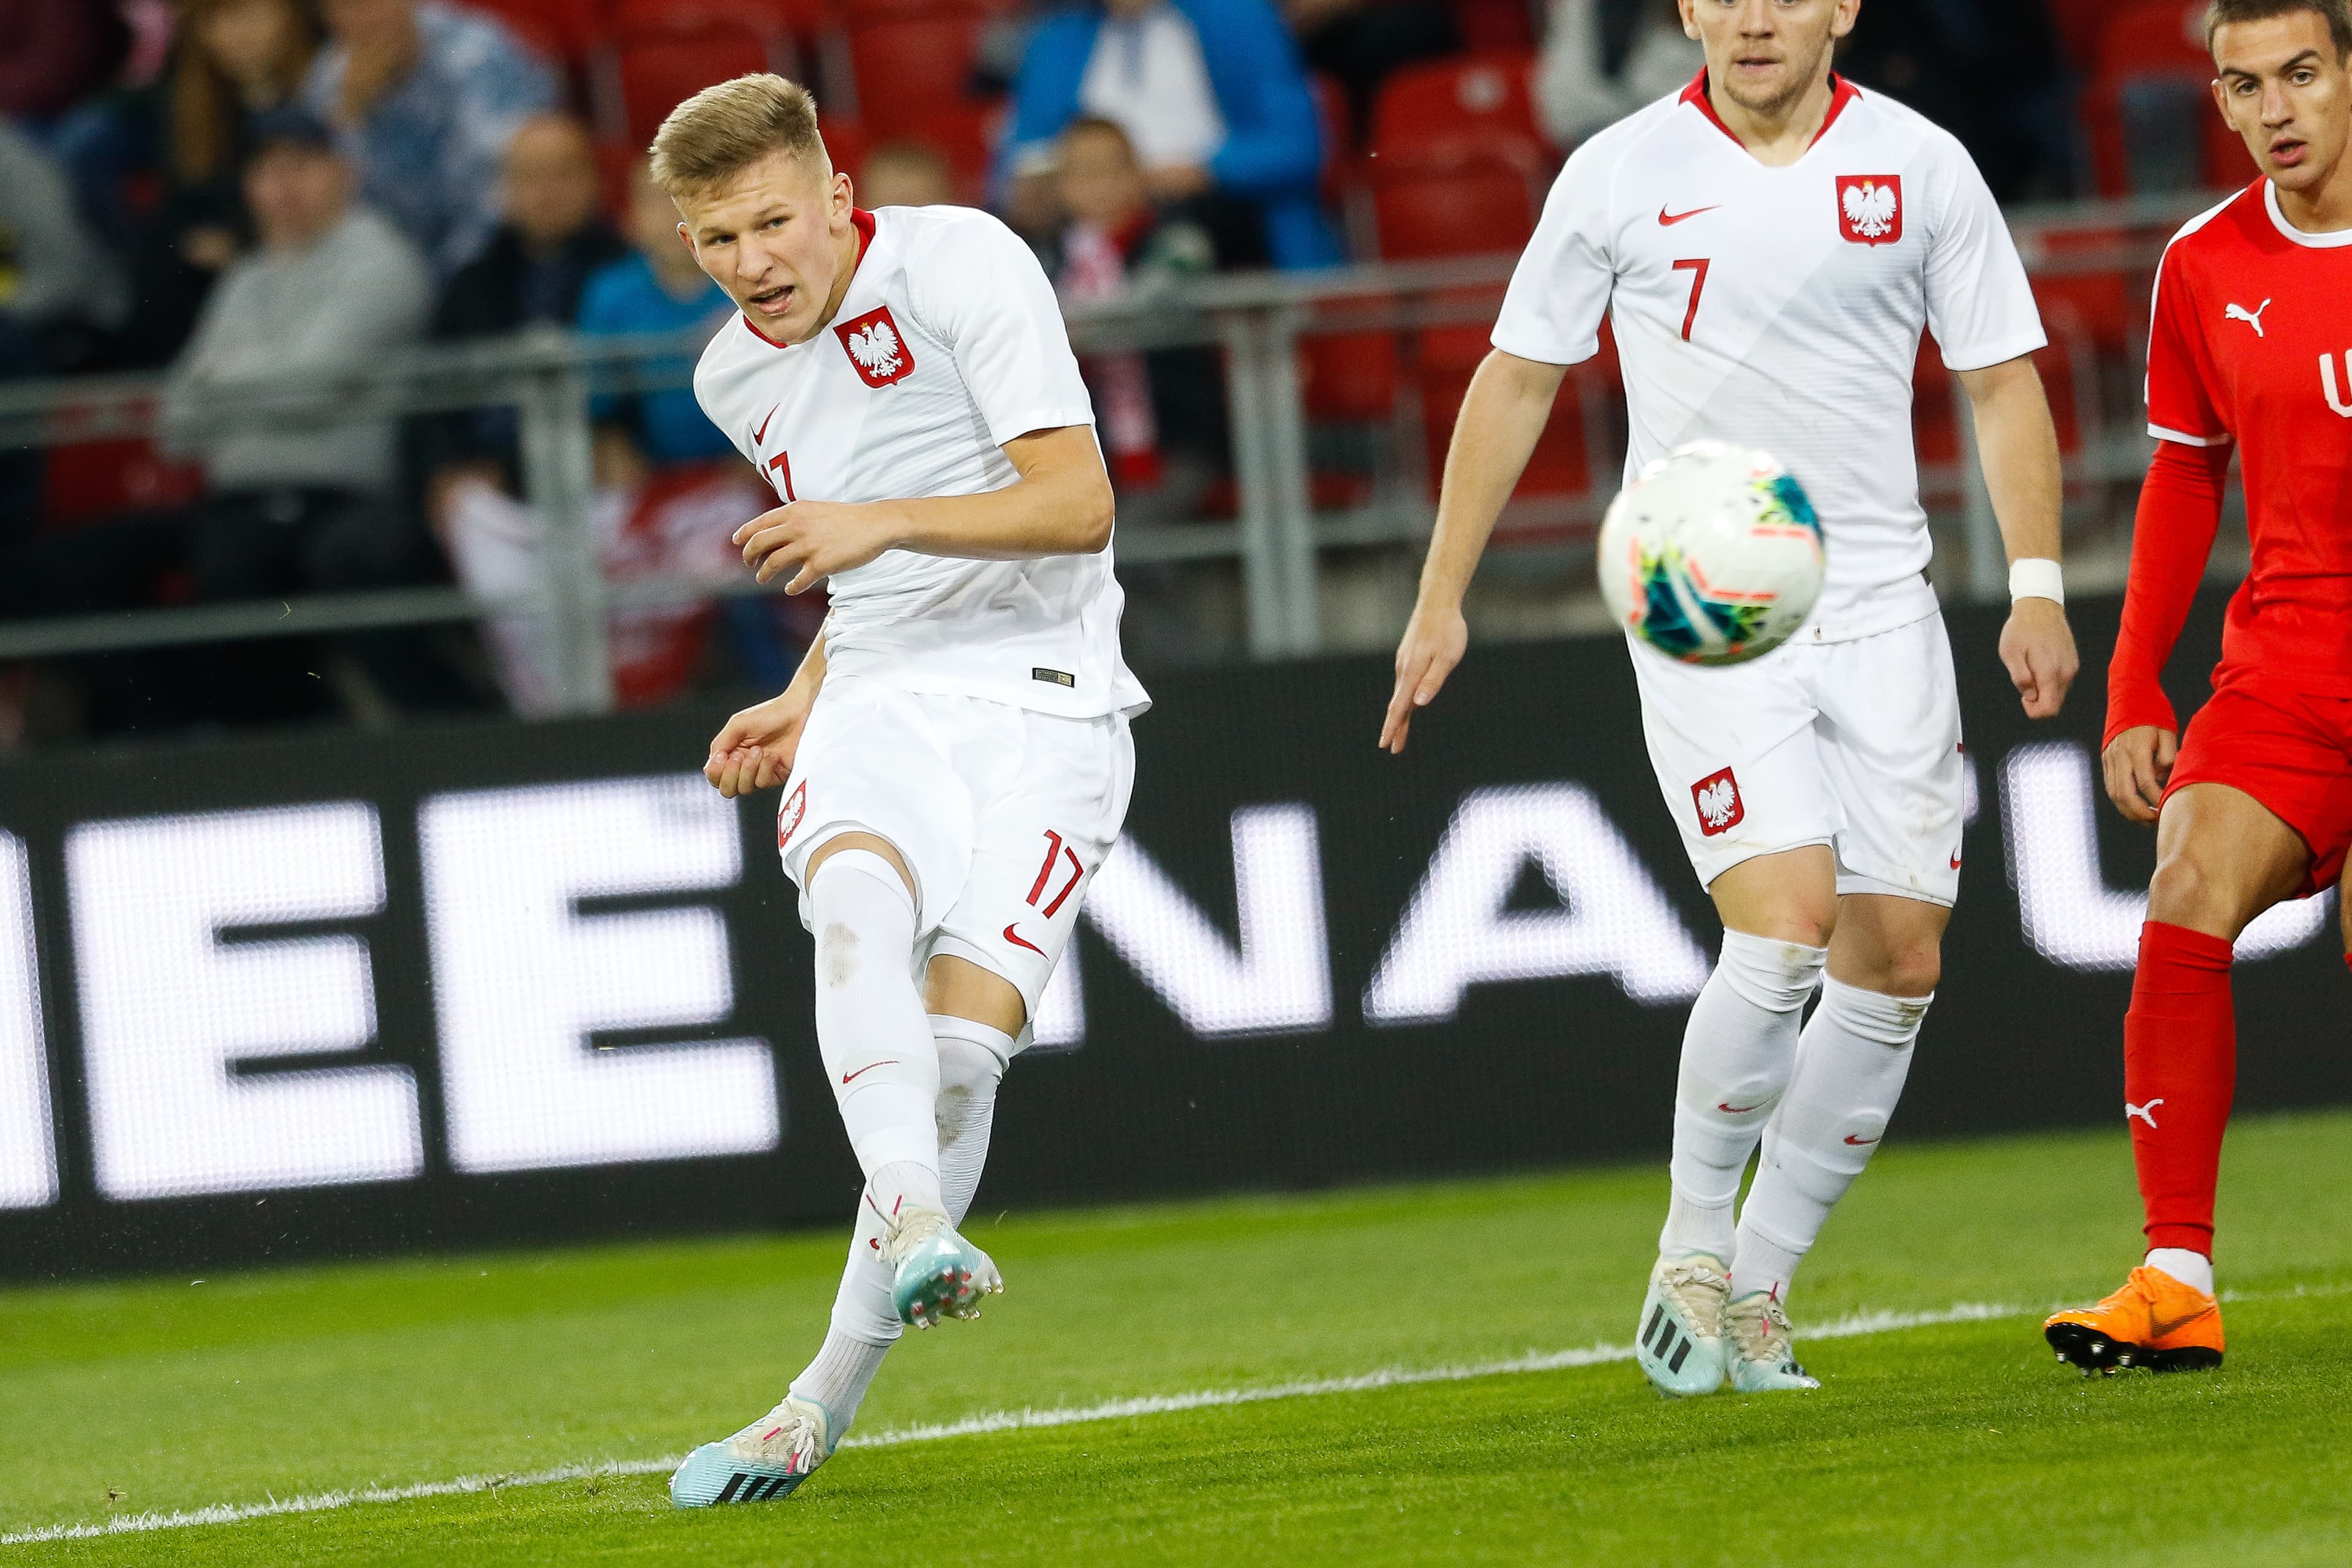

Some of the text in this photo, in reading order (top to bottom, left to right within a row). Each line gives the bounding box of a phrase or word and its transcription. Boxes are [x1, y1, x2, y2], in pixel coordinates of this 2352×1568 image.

[1673, 258, 1711, 341] 7
[1026, 829, 1084, 919] 17
[0, 771, 780, 1208] EE
